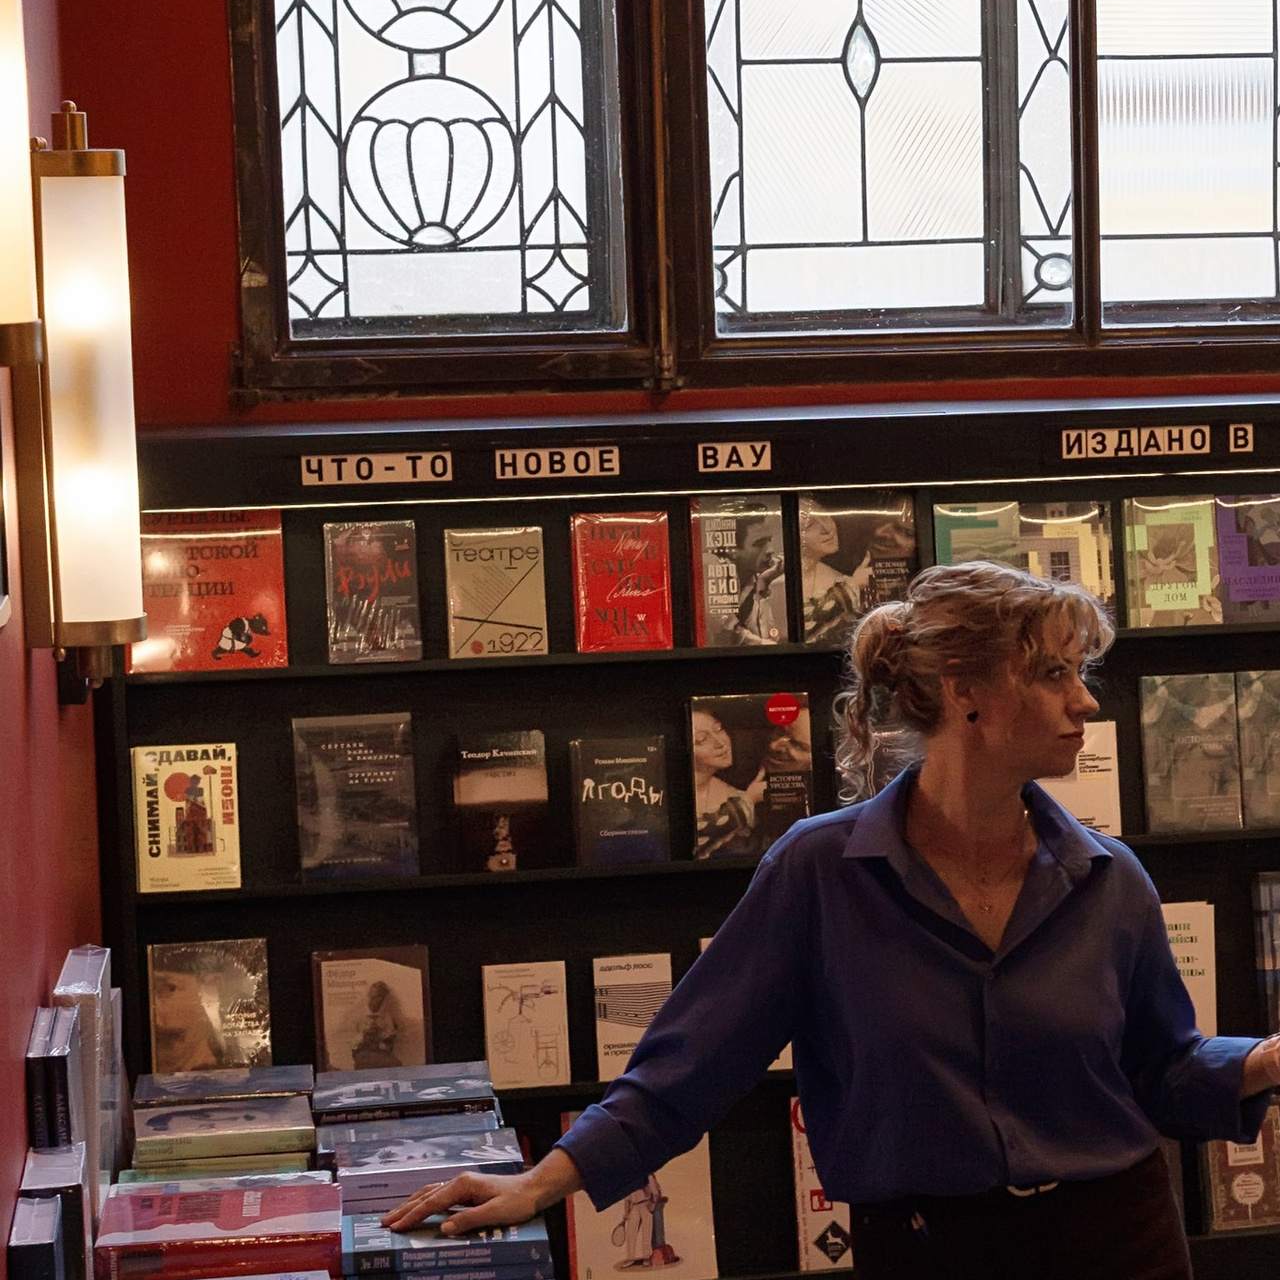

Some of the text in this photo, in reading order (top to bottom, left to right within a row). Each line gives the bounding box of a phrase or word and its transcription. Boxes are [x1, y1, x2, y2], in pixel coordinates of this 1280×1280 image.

[1066, 430, 1208, 456] ИЗДАНО
[1232, 428, 1250, 448] В
[306, 445, 769, 482] ЧТО-ТО НОВОЕ ВАУ
[706, 531, 737, 547] КЭШ
[451, 546, 540, 567] театре
[708, 563, 736, 580] АВТО
[708, 579, 738, 594] БИО
[1163, 592, 1188, 603] ДОМ
[487, 632, 543, 653] 1922
[145, 745, 232, 765] СДАВАЙ,
[461, 751, 491, 760] Теодор
[603, 1041, 638, 1051] орнамен
